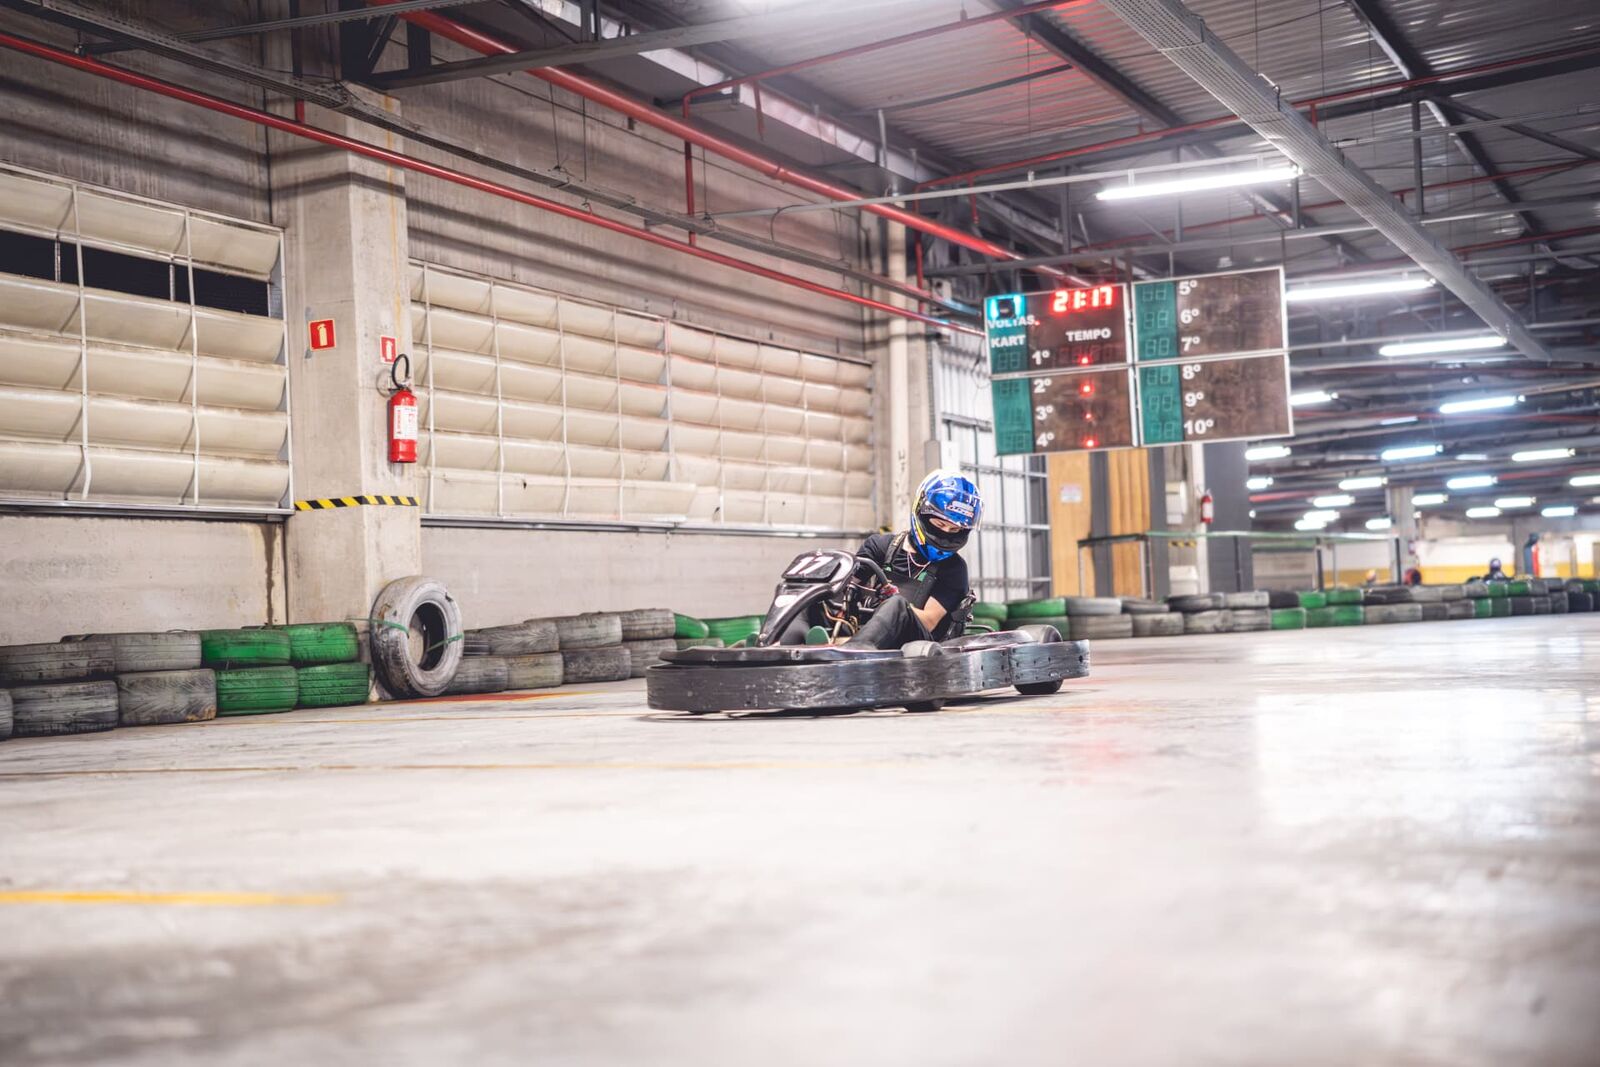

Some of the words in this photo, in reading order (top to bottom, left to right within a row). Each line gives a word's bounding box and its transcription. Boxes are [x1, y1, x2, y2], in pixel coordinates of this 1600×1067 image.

[1052, 286, 1113, 312] 21:17
[991, 334, 1027, 348] KART
[1065, 327, 1112, 342] TEMPO
[785, 556, 834, 576] 17
